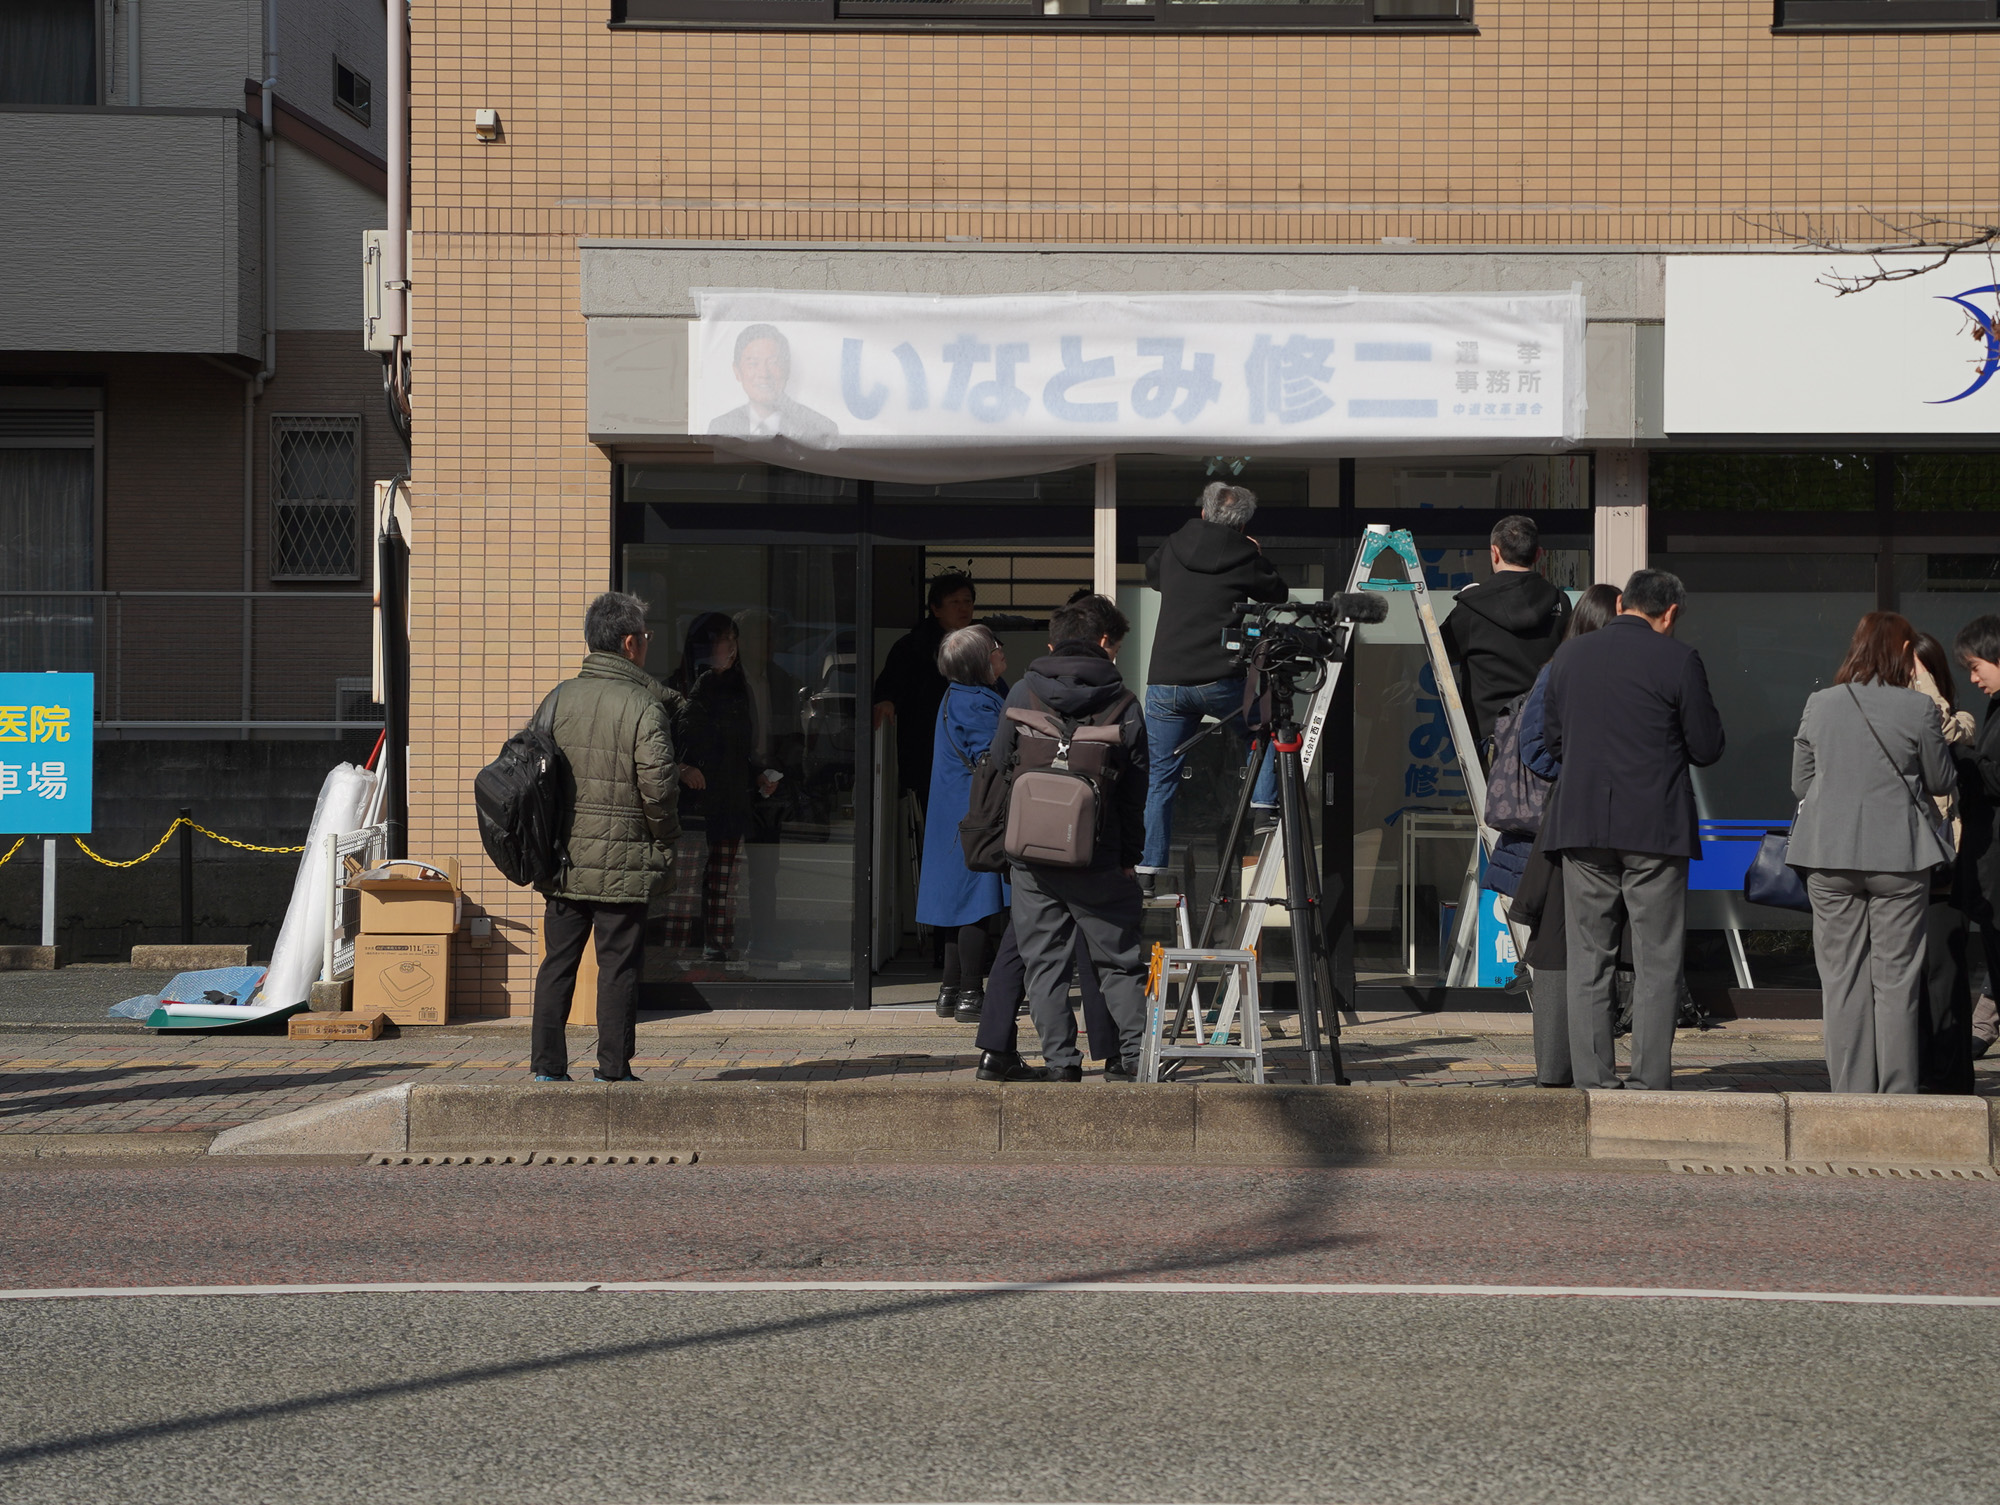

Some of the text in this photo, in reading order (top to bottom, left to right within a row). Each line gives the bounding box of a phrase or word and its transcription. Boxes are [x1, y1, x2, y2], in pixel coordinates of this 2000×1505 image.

[1455, 369, 1542, 394] 事務所
[0, 704, 71, 744] 医院
